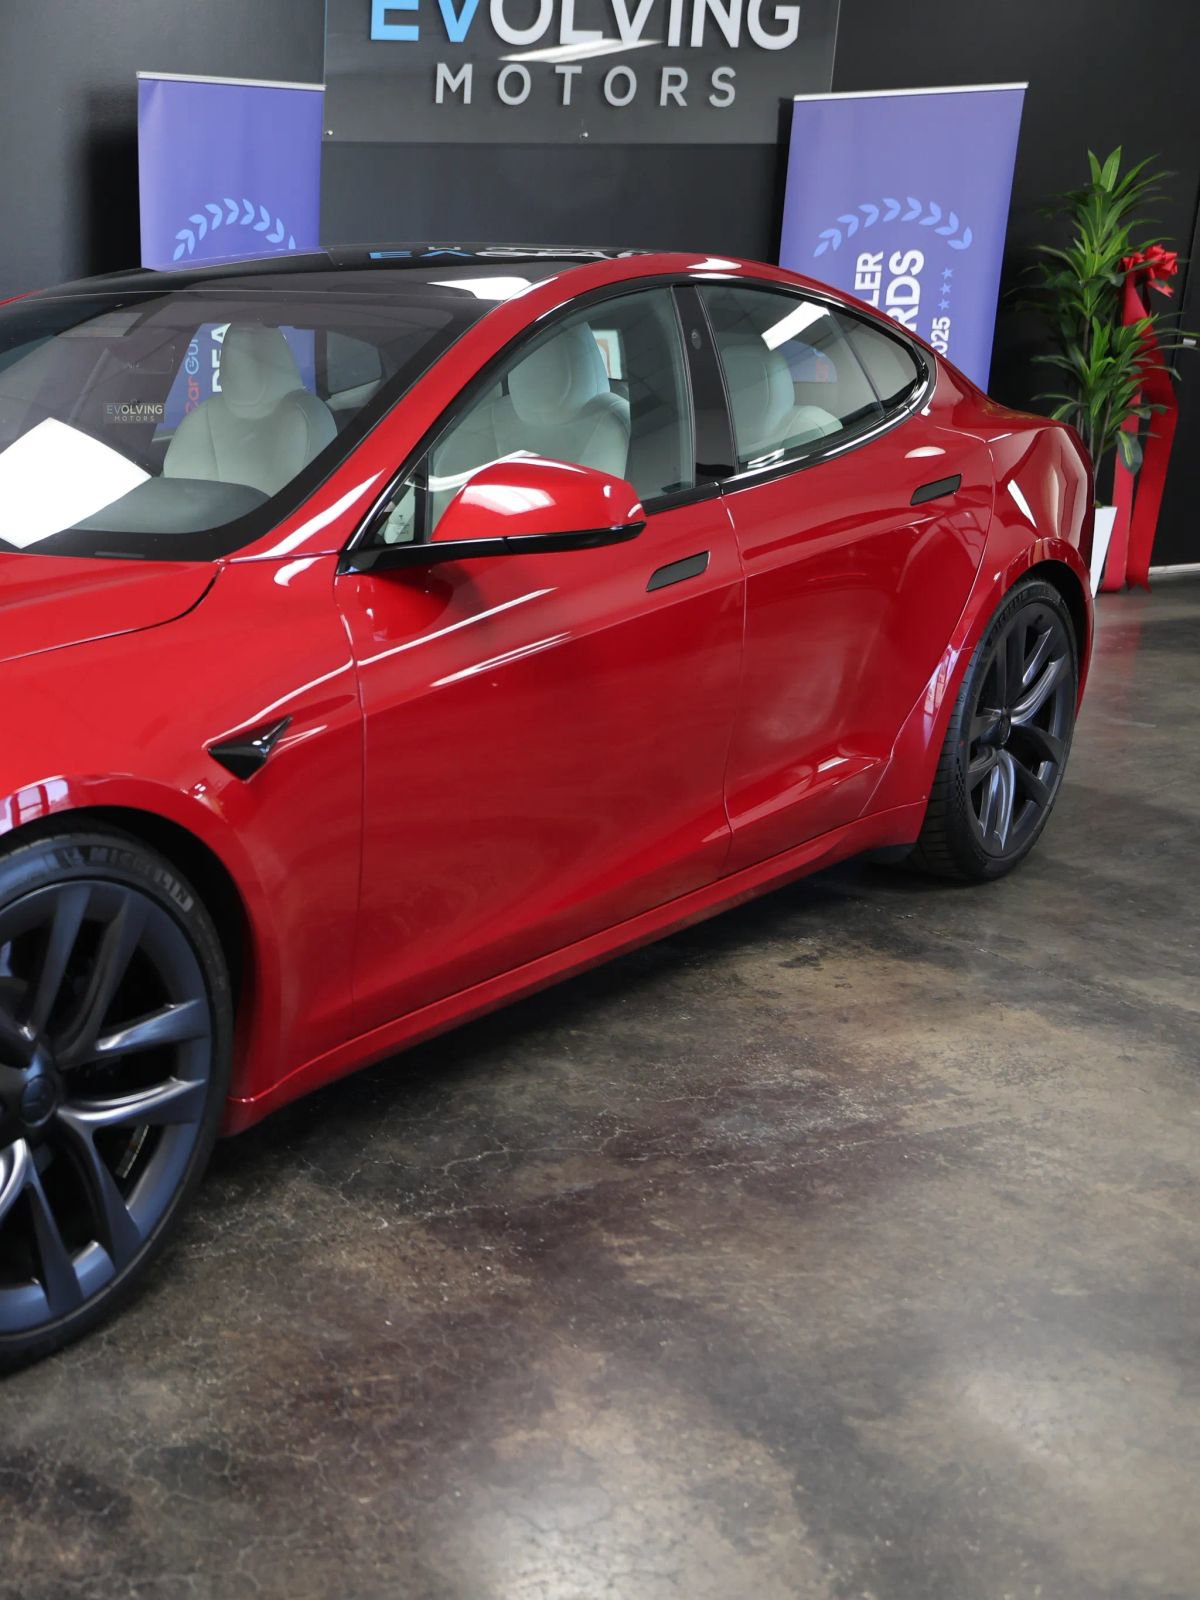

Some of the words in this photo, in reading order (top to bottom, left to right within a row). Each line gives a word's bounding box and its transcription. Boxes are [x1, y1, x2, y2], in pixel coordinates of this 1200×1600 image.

[371, 0, 800, 50] EVOLVING
[435, 63, 737, 108] MOTORS
[930, 316, 951, 358] 025
[106, 404, 163, 415] EVOLVING
